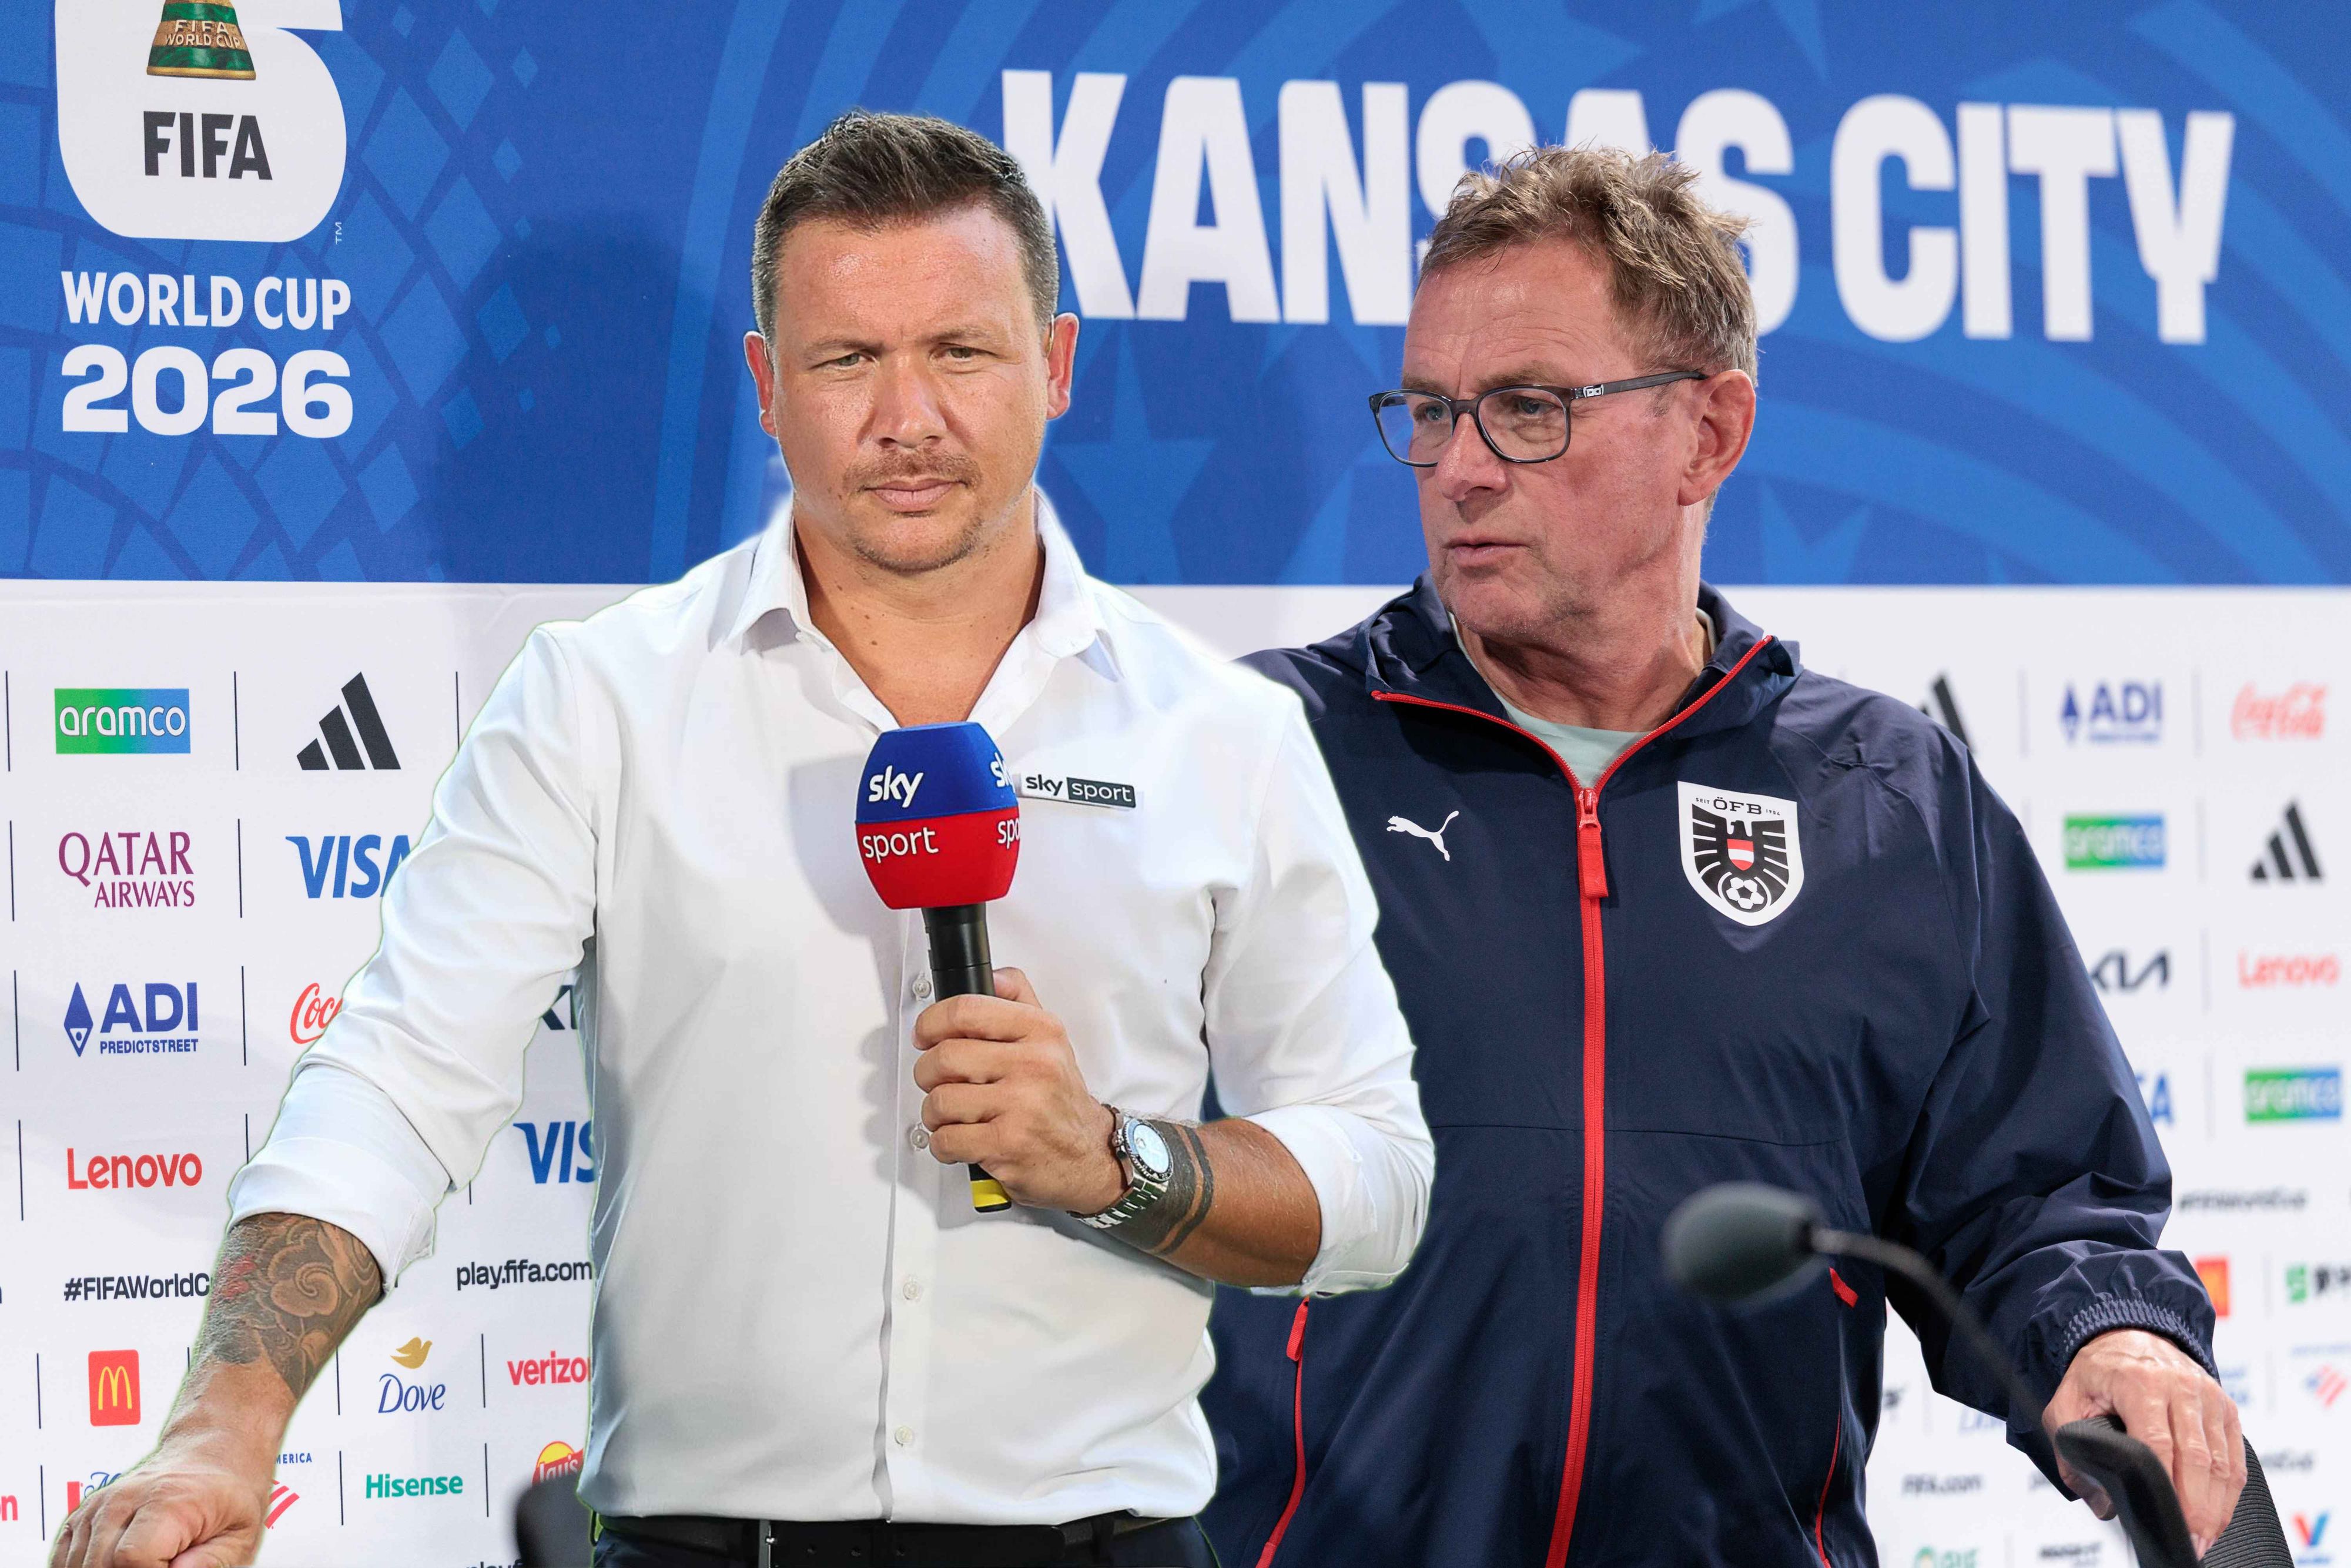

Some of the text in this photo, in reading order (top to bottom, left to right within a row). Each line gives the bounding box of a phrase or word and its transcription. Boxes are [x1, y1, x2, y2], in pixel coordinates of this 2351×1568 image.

[165, 33, 240, 48] WORLD CUP
[175, 19, 229, 34] FIFA
[143, 111, 273, 180] FIFA
[1830, 93, 2235, 346] CITY
[61, 271, 351, 330] WORLD CUP
[61, 344, 353, 438] 2026
[59, 706, 186, 736] aramco
[2089, 681, 2164, 725] ADI
[869, 765, 924, 808] sky
[990, 752, 1016, 793] sk
[1026, 774, 1131, 802] sky sport
[1713, 796, 1761, 815] ÖFB
[59, 832, 194, 887] QATAR
[862, 827, 939, 863] sport
[94, 880, 195, 908] AIRWAYS
[100, 982, 199, 1033] ADI
[100, 1039, 199, 1054] PREDICTSTREET
[67, 1148, 202, 1190] Lenovo
[457, 1259, 592, 1291] play.fifa.com
[379, 1373, 446, 1413] Dove
[366, 1474, 463, 1499] Hisense
